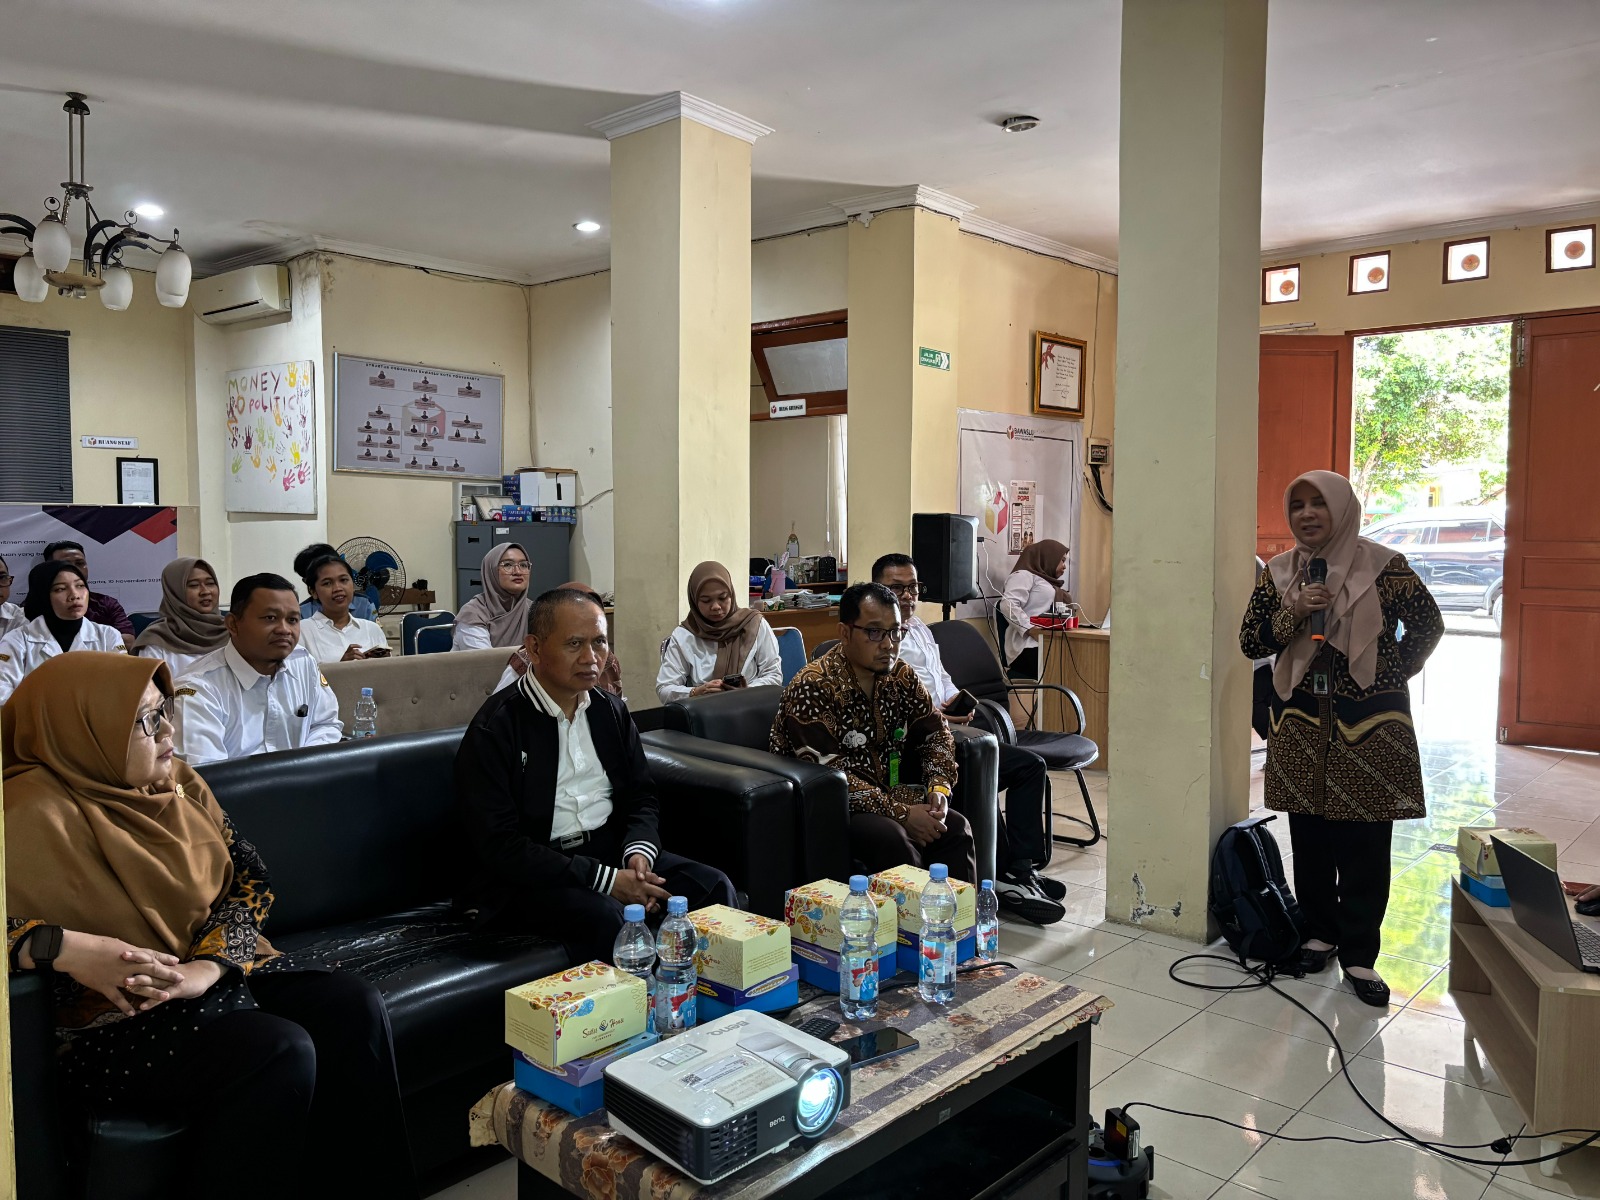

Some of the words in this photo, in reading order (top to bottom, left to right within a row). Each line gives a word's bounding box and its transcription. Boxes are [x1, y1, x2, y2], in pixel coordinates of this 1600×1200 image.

[228, 370, 281, 396] MONEY
[706, 1020, 750, 1036] BenQ
[769, 1115, 786, 1128] BenQ
